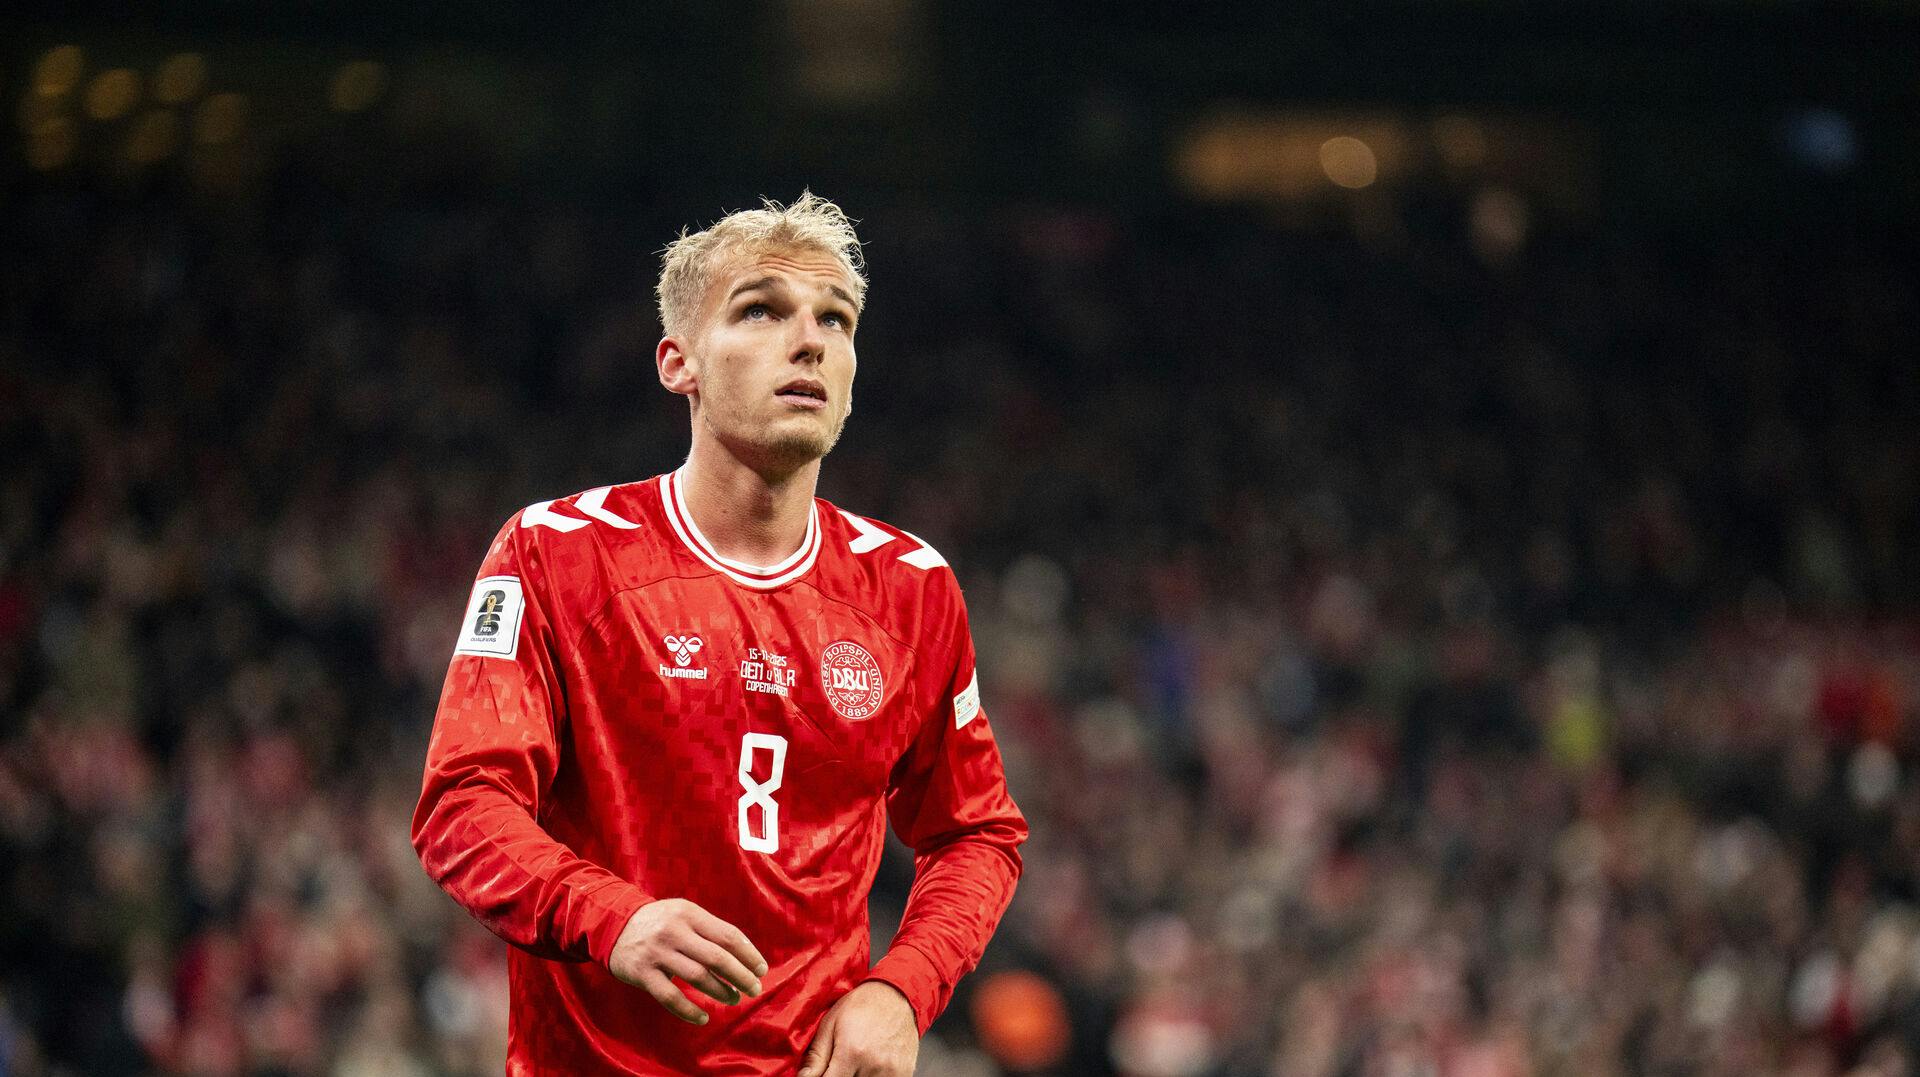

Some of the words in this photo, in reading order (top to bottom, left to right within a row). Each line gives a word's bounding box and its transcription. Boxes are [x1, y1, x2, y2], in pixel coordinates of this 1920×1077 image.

[748, 647, 787, 667] 15-11-2025
[659, 664, 708, 680] hummel
[740, 661, 764, 681] DEN
[773, 667, 796, 687] BLR
[831, 668, 870, 690] DBU
[822, 661, 839, 706] DANSK
[841, 706, 868, 717] 1889
[738, 732, 788, 855] 8
